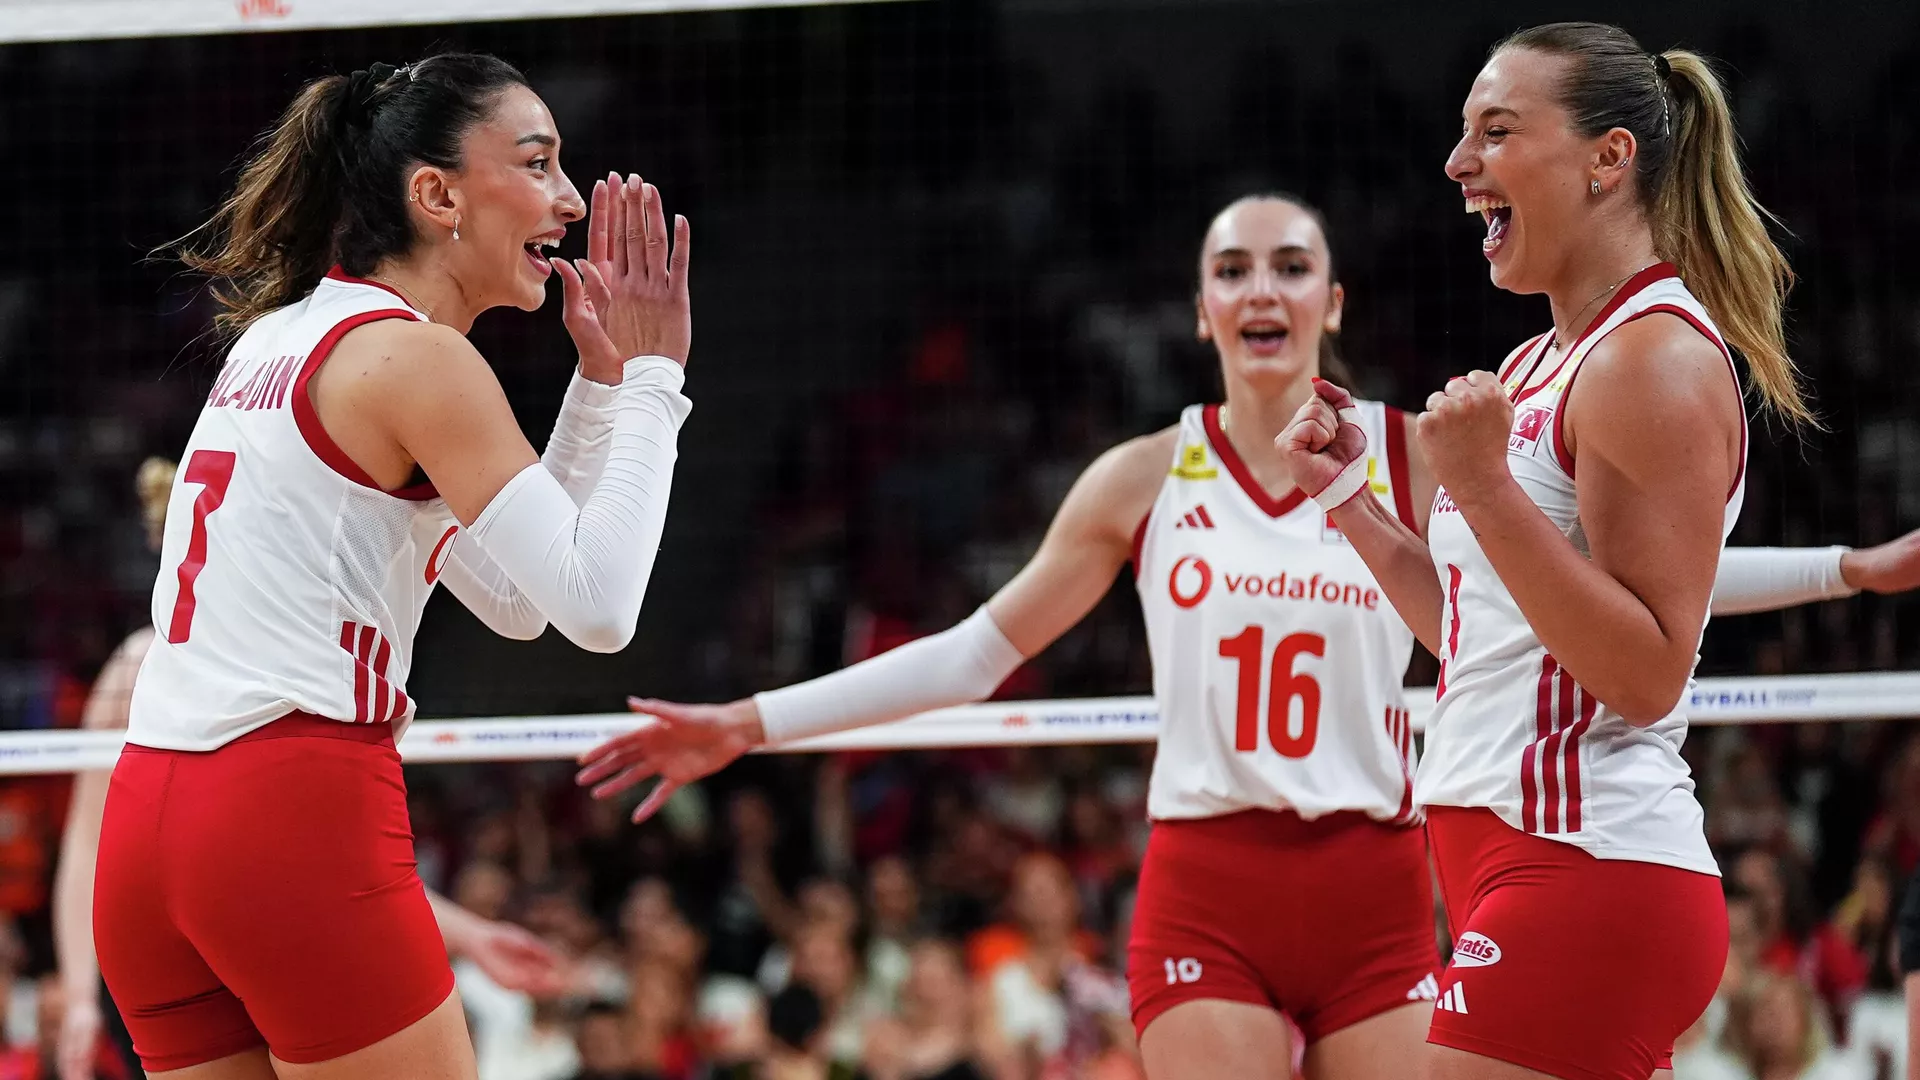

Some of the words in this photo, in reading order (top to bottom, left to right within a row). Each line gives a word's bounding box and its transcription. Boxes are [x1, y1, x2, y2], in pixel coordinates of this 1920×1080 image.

[208, 355, 304, 411] ALADIN
[1508, 436, 1525, 450] UR
[168, 449, 236, 644] 7
[1224, 571, 1379, 610] vodafone
[1218, 624, 1326, 760] 16
